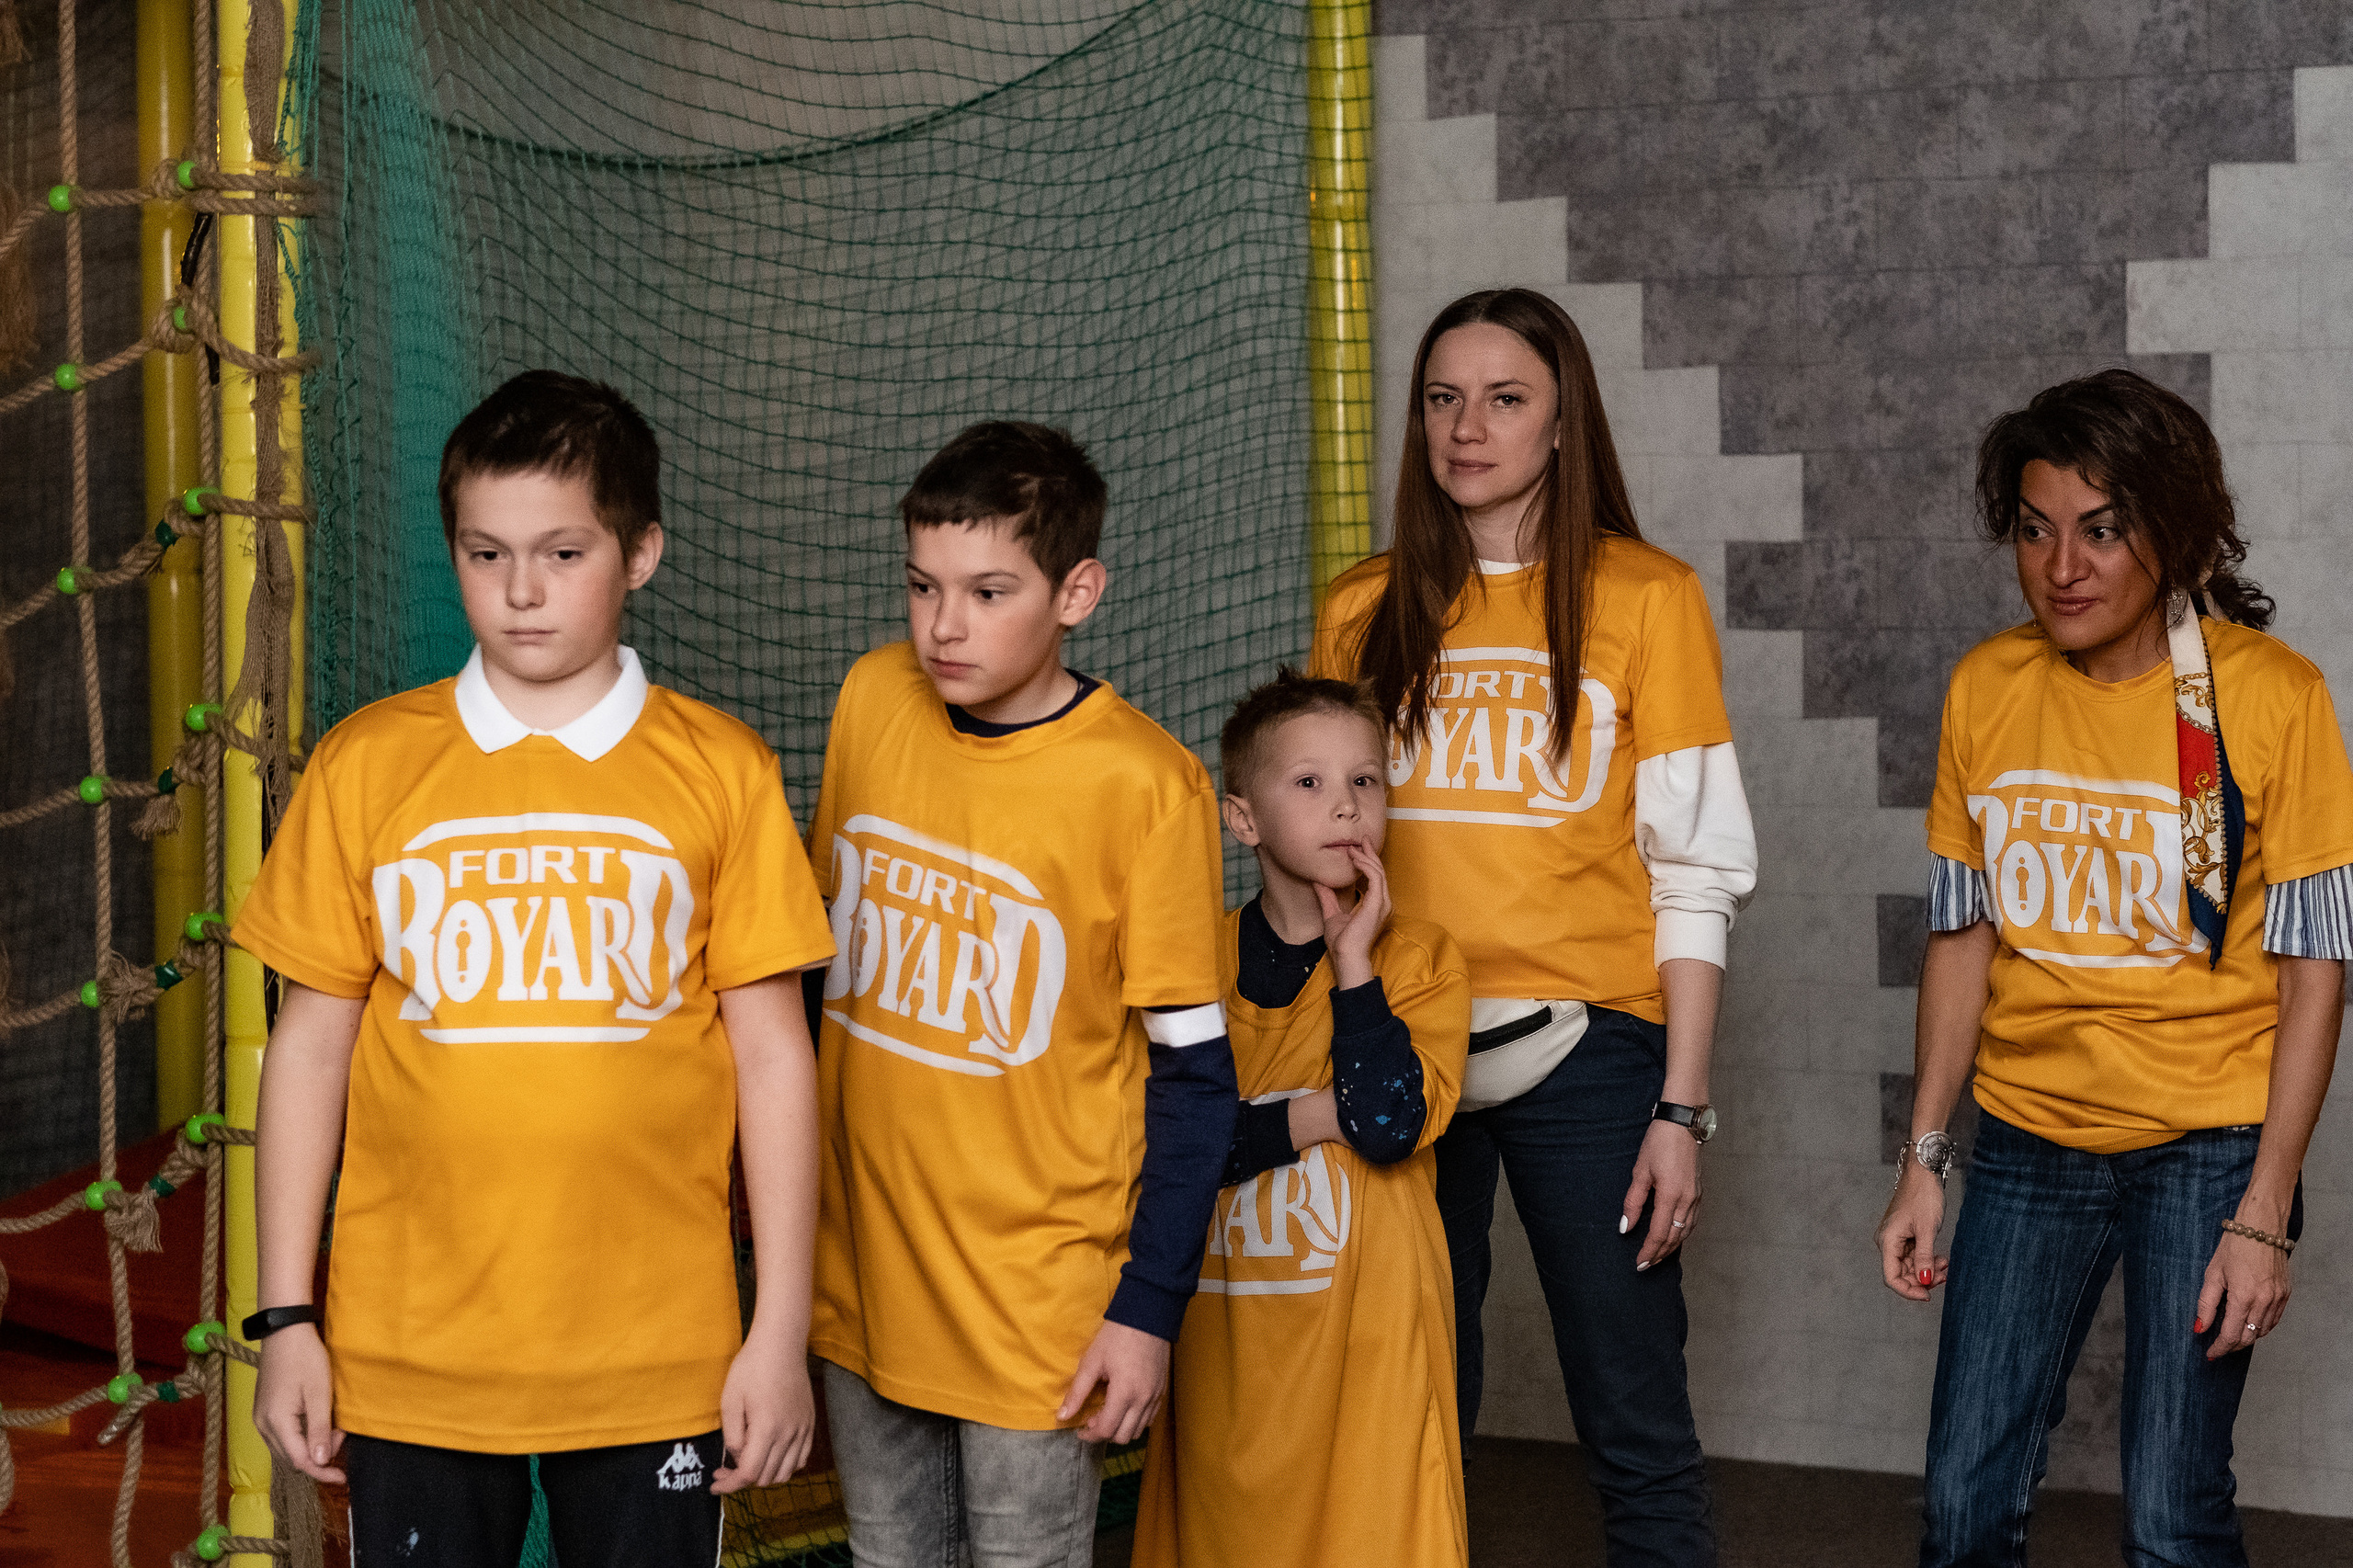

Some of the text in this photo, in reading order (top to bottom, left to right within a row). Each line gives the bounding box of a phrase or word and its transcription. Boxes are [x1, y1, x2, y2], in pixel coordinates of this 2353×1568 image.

[1427, 670, 1536, 699] ORT
[2011, 796, 2143, 841] FORT
[449, 844, 616, 888] FORT
[862, 846, 987, 921] FORT
